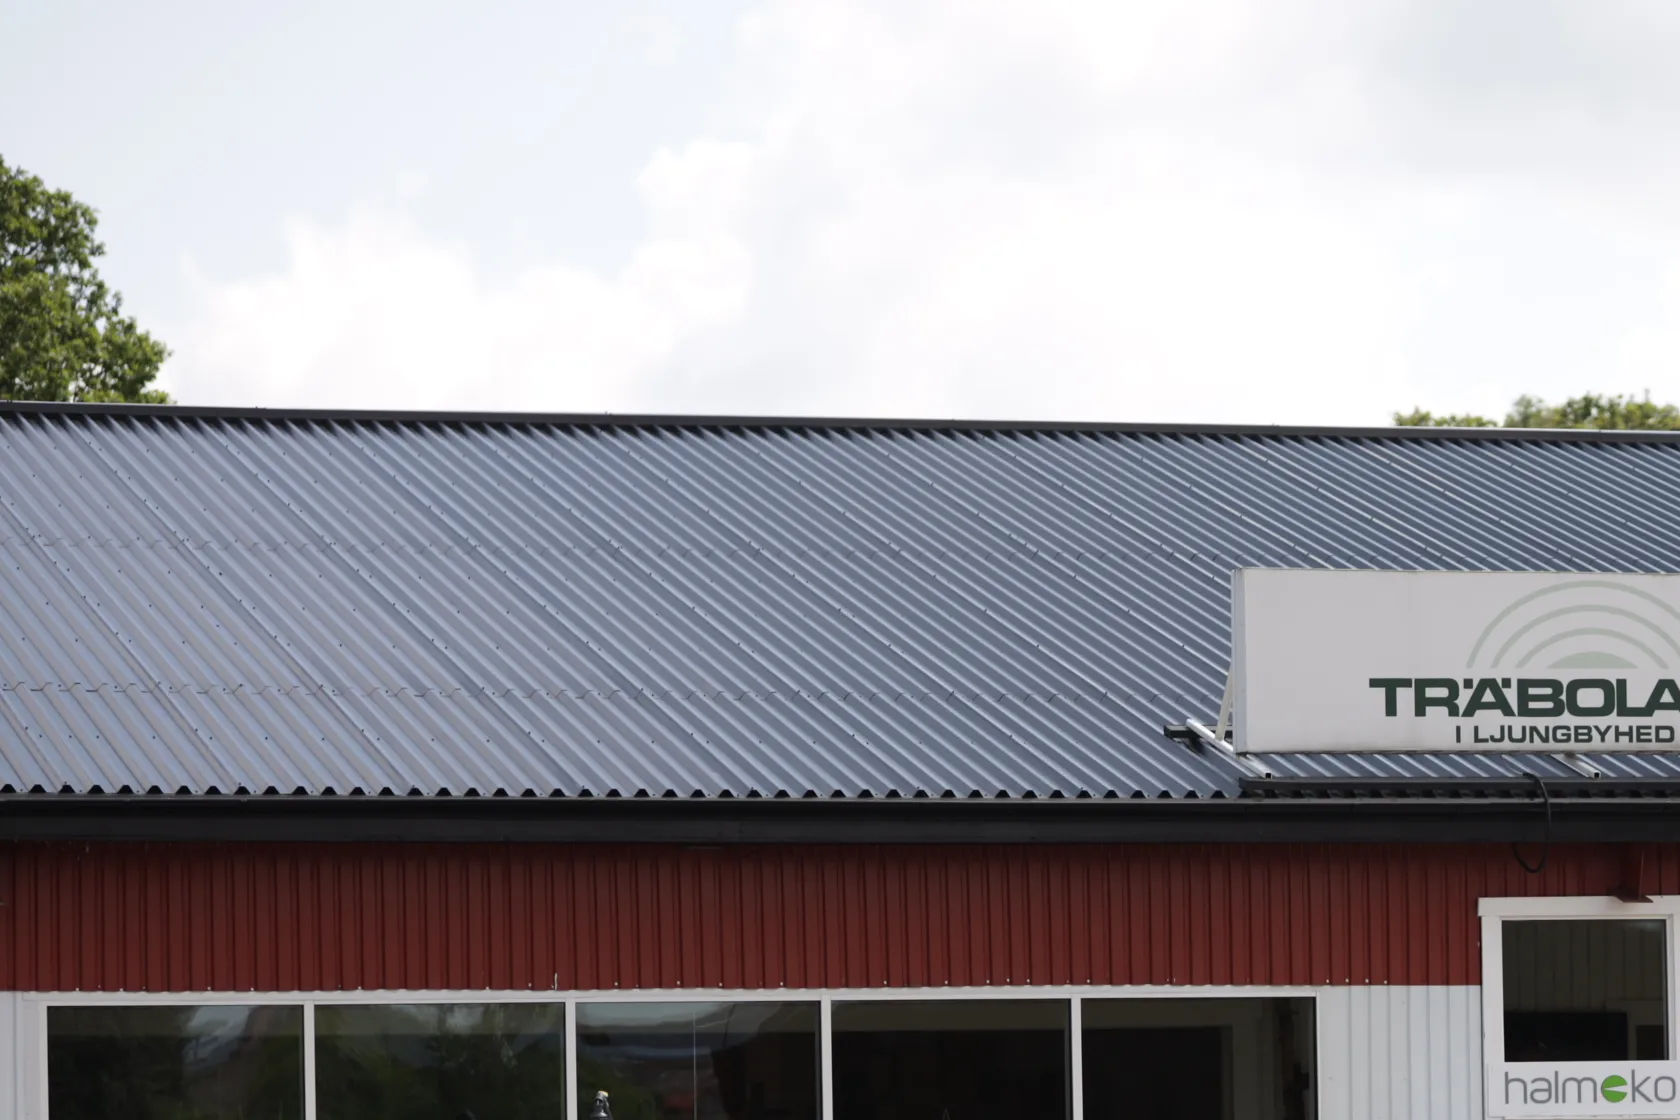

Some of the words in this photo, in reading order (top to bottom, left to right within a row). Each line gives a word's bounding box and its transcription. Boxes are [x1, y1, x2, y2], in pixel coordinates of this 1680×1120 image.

[1455, 725, 1462, 744] I
[1473, 725, 1676, 744] LJUNGBYHED
[1504, 1069, 1677, 1105] halmeko
